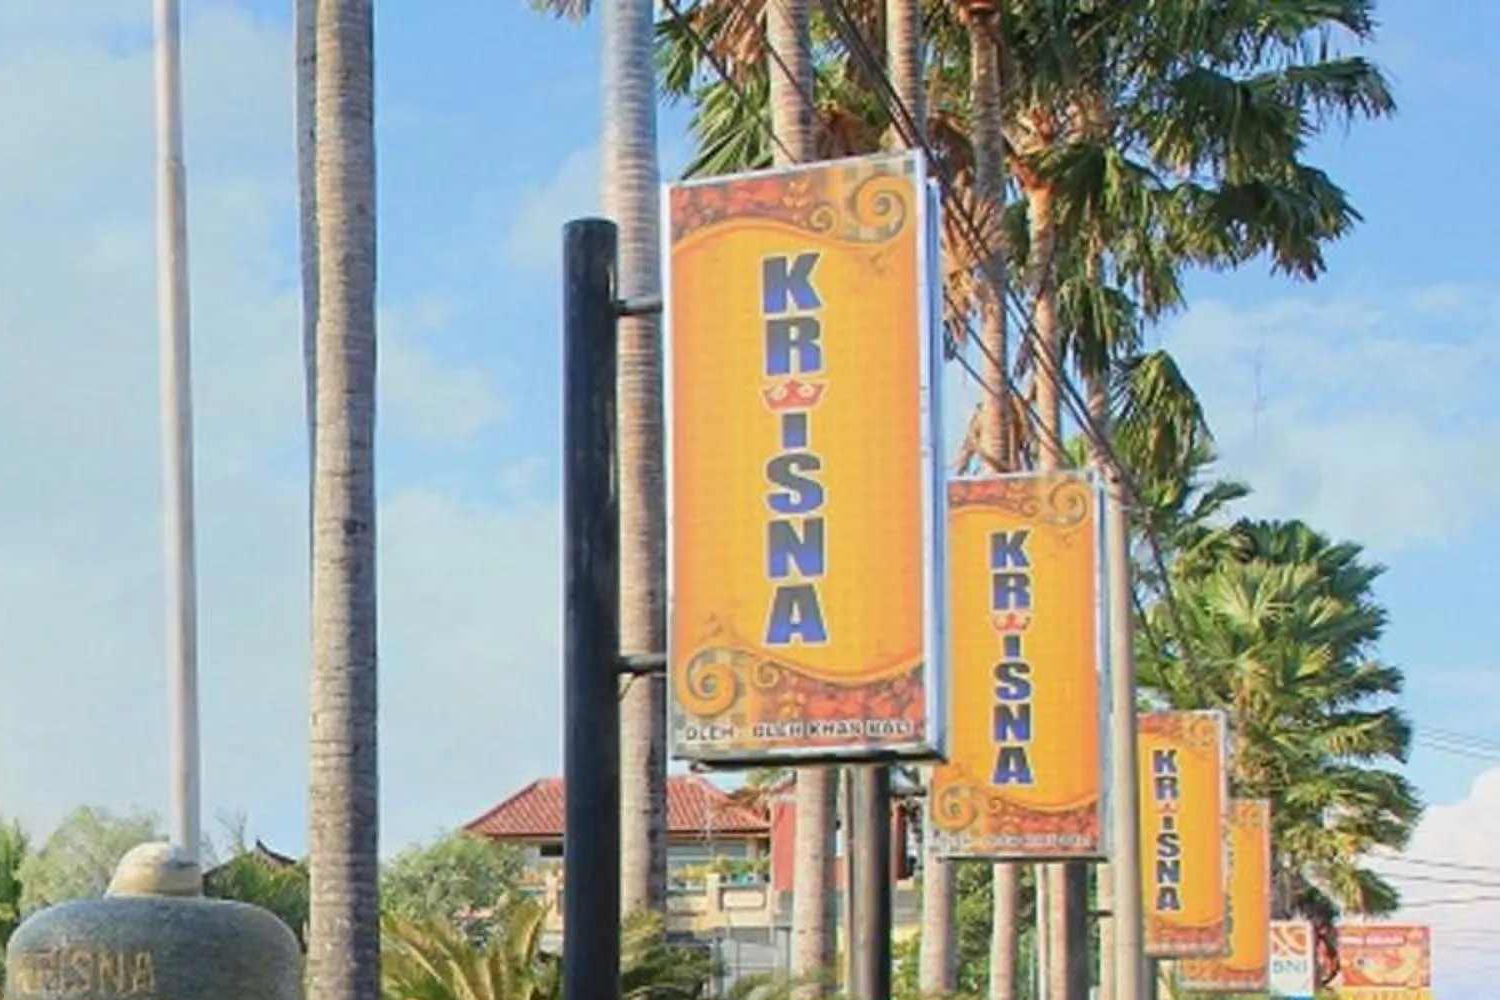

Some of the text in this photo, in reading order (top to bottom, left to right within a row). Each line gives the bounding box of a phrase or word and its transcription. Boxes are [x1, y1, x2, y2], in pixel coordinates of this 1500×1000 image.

[760, 251, 827, 647] KRISNA
[989, 529, 1034, 785] KRISNA
[1153, 748, 1182, 911] KRISNA
[1272, 959, 1308, 975] BNI
